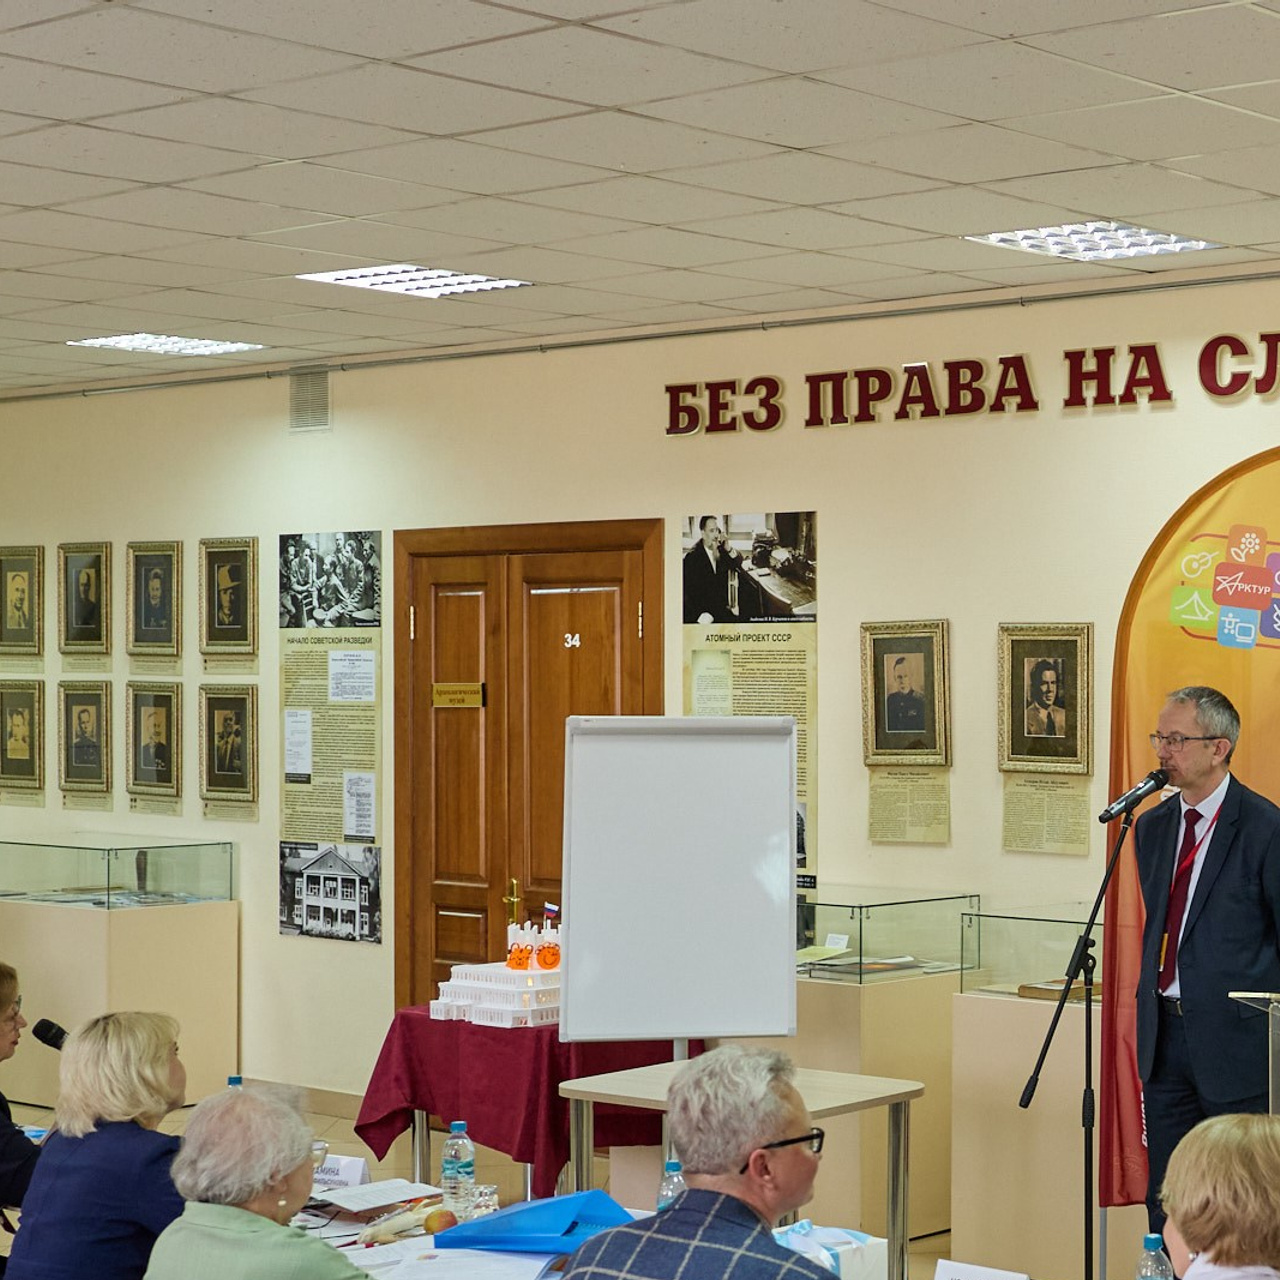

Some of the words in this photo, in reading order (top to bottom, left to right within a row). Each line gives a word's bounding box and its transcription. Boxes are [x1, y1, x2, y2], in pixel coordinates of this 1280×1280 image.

[665, 376, 783, 436] БЕЗ
[804, 356, 1040, 428] ПРАВА
[1064, 344, 1174, 408] НА
[287, 637, 308, 645] НАЧАЛО
[310, 636, 342, 645] СОВЕТСКОЙ
[344, 636, 373, 645] РАЗВЕДКИ
[564, 633, 580, 648] 34
[705, 632, 740, 642] АТОМНЫЙ
[742, 633, 770, 642] ПРОЕКТ
[772, 633, 792, 642] СССР
[313, 1166, 340, 1177] АМИНА
